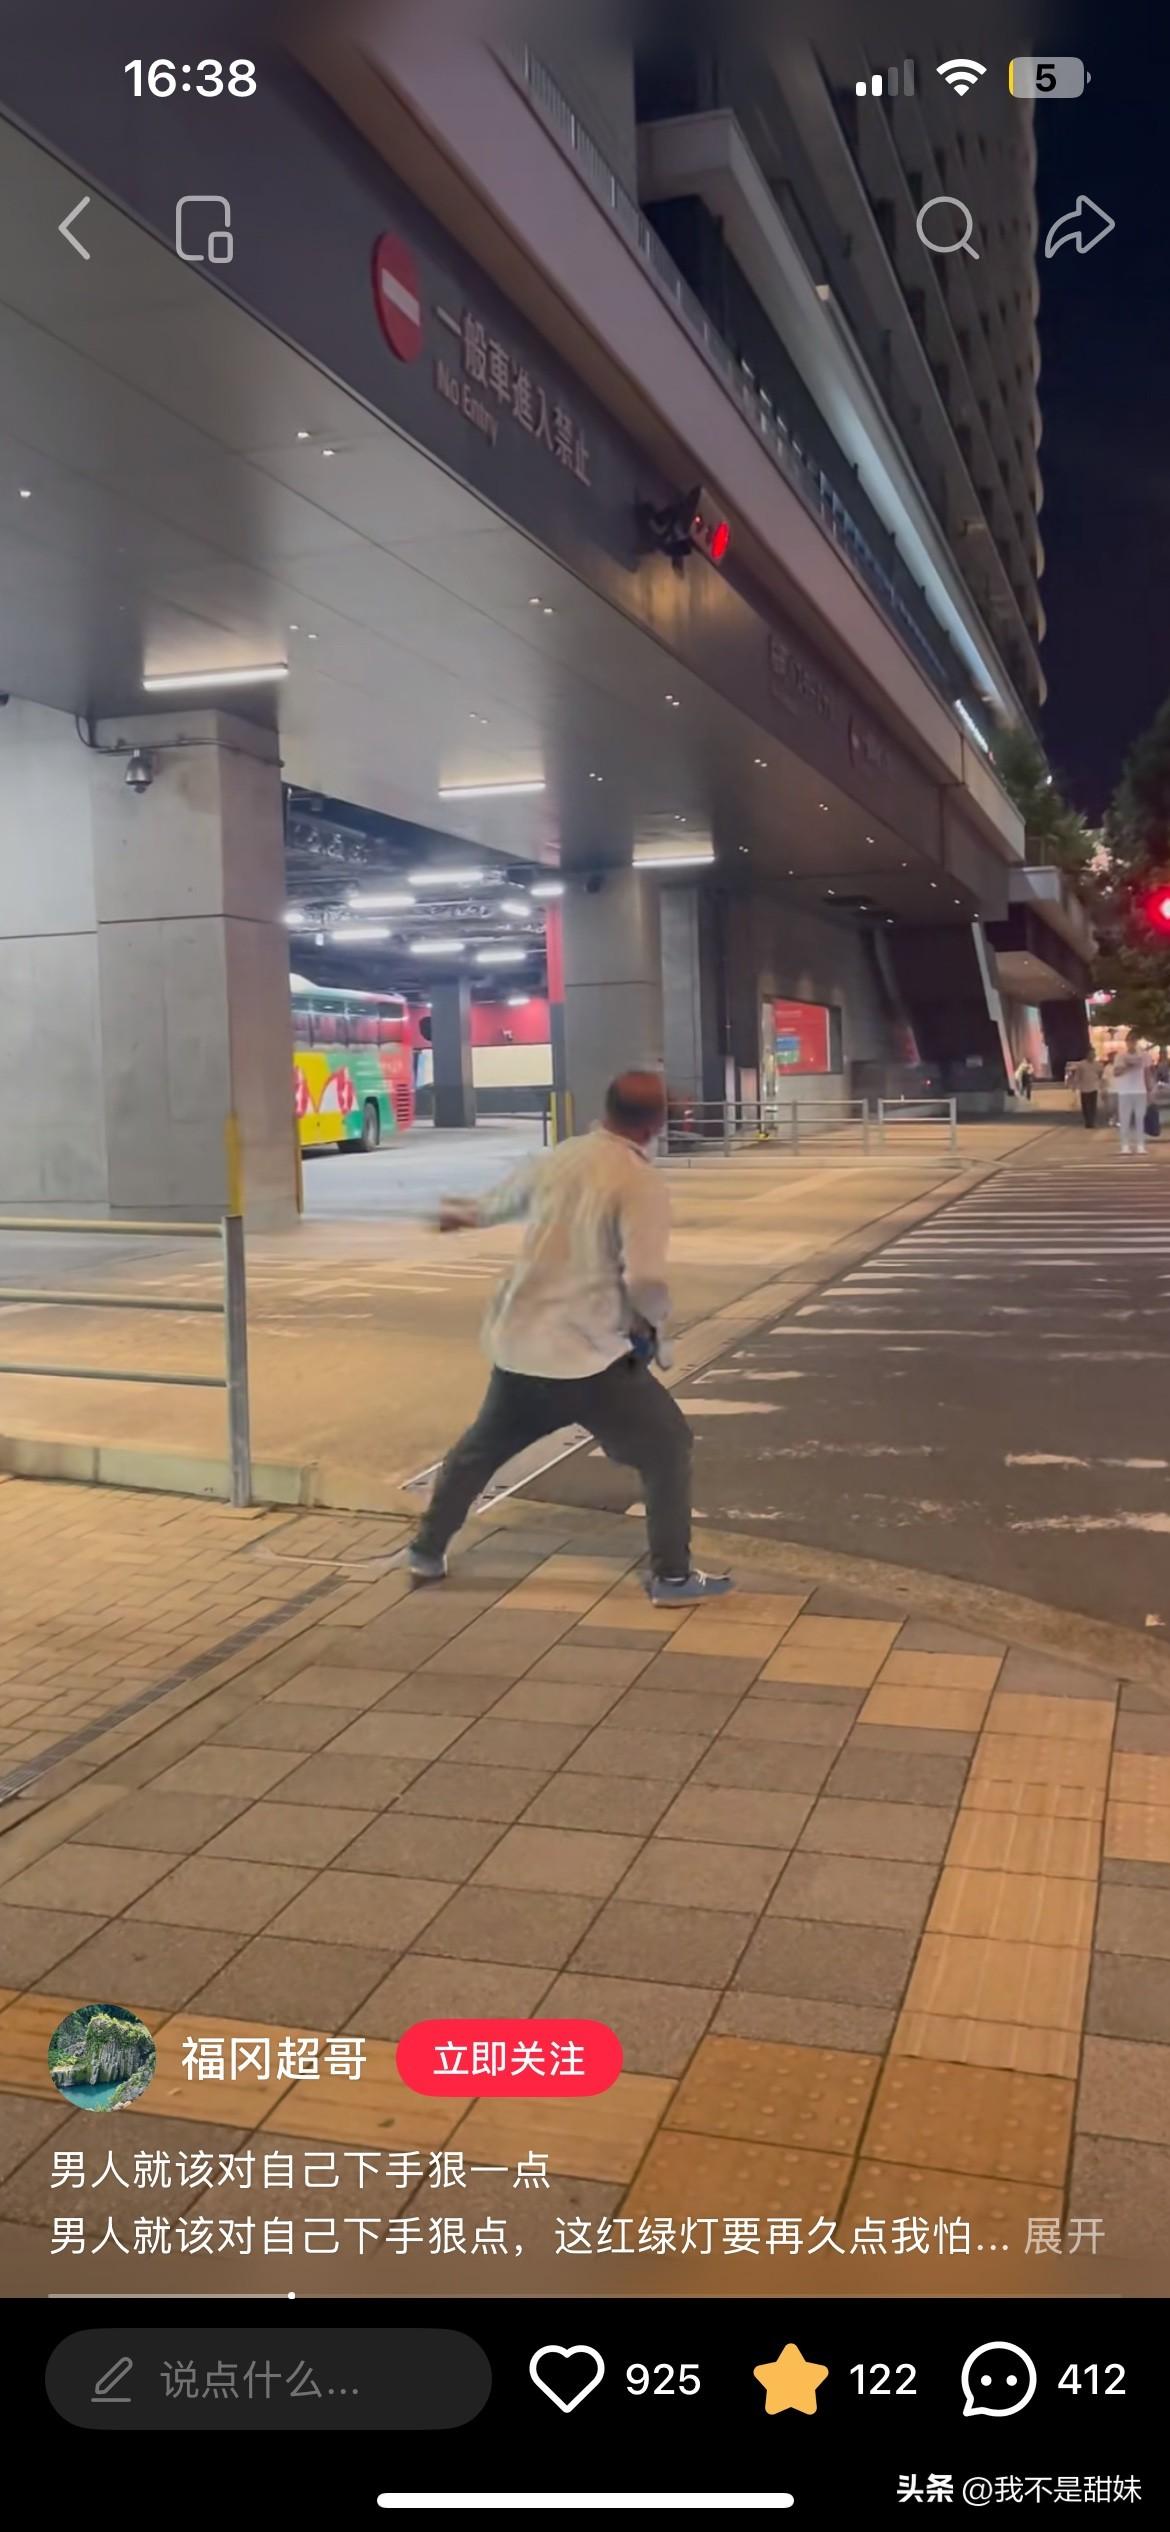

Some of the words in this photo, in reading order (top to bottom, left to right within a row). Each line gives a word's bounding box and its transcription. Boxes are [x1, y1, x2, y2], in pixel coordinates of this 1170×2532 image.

[436, 360, 460, 407] No
[436, 305, 592, 487] 一般車進入禁止
